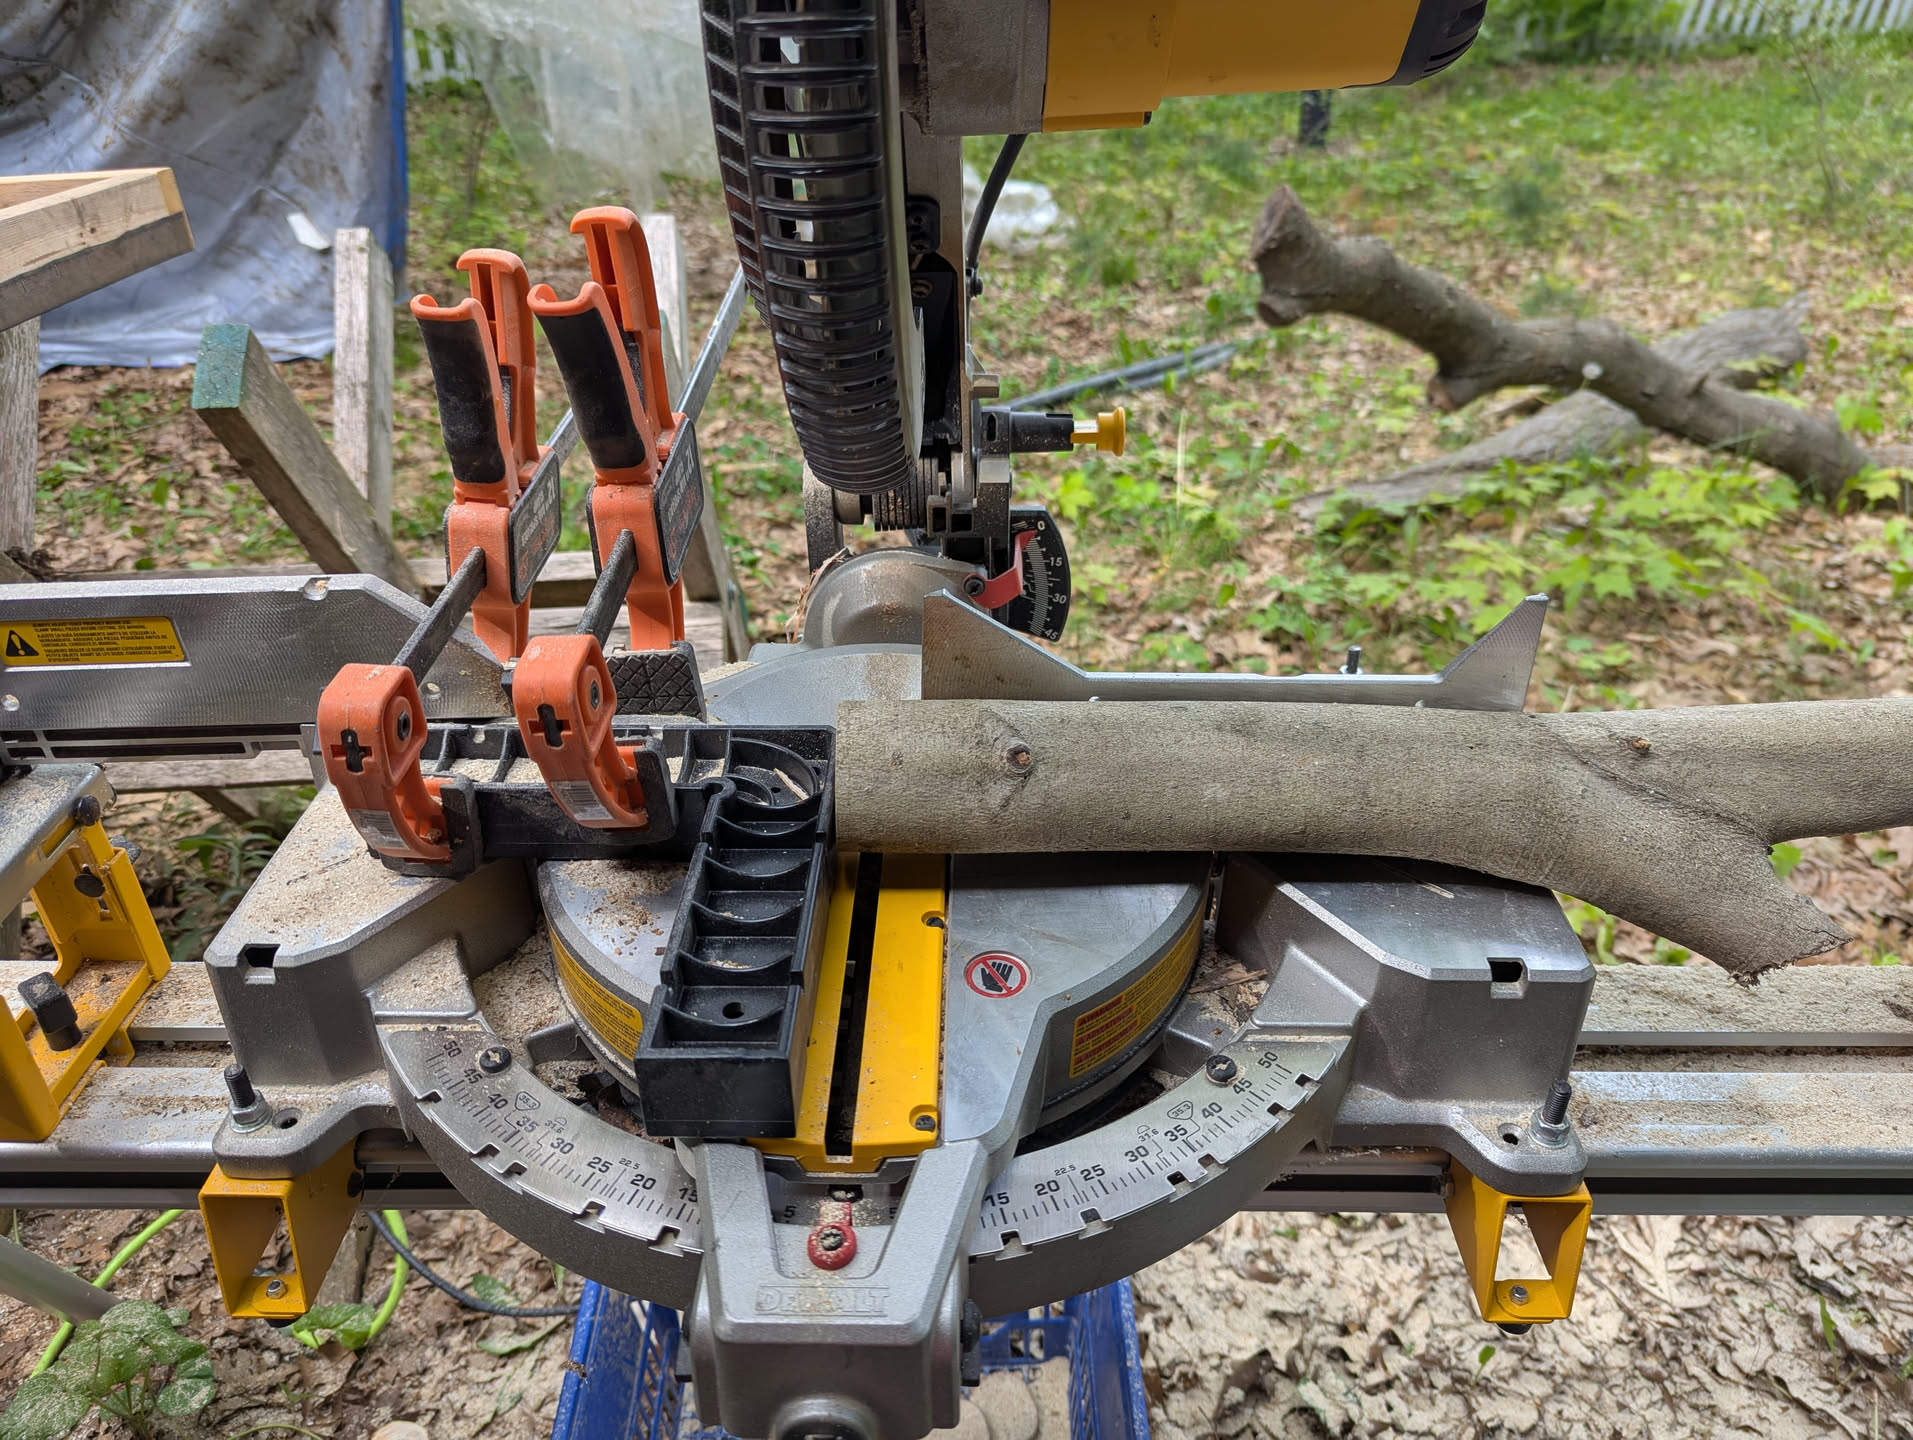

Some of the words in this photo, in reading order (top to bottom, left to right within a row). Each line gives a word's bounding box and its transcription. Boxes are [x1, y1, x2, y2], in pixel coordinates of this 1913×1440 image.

[1037, 520, 1046, 531] 0
[1049, 557, 1063, 567] 15
[1052, 593, 1067, 605] 30
[1044, 628, 1059, 641] 45
[443, 1040, 462, 1058] 50
[1257, 1051, 1278, 1069] 50
[463, 1068, 483, 1084] 45
[1232, 1077, 1253, 1095] 45
[488, 1093, 508, 1109] 40
[519, 1095, 537, 1109] 35.3
[1171, 1103, 1191, 1118] 35.3
[1201, 1102, 1223, 1119] 40
[516, 1115, 540, 1133] 35
[544, 1119, 564, 1134] 31.6
[1138, 1128, 1159, 1142] 31.6
[1164, 1124, 1188, 1142] 35
[550, 1137, 574, 1154] 30
[1124, 1145, 1150, 1163] 30
[587, 1156, 613, 1174] 25
[618, 1157, 641, 1170] 22.5
[1054, 1164, 1077, 1177] 22.5
[1080, 1164, 1106, 1182] 25
[630, 1173, 657, 1190] 20
[1034, 1179, 1060, 1196] 20
[679, 1187, 698, 1203] 15
[984, 1191, 1010, 1207] 15
[783, 1205, 797, 1218] 5
